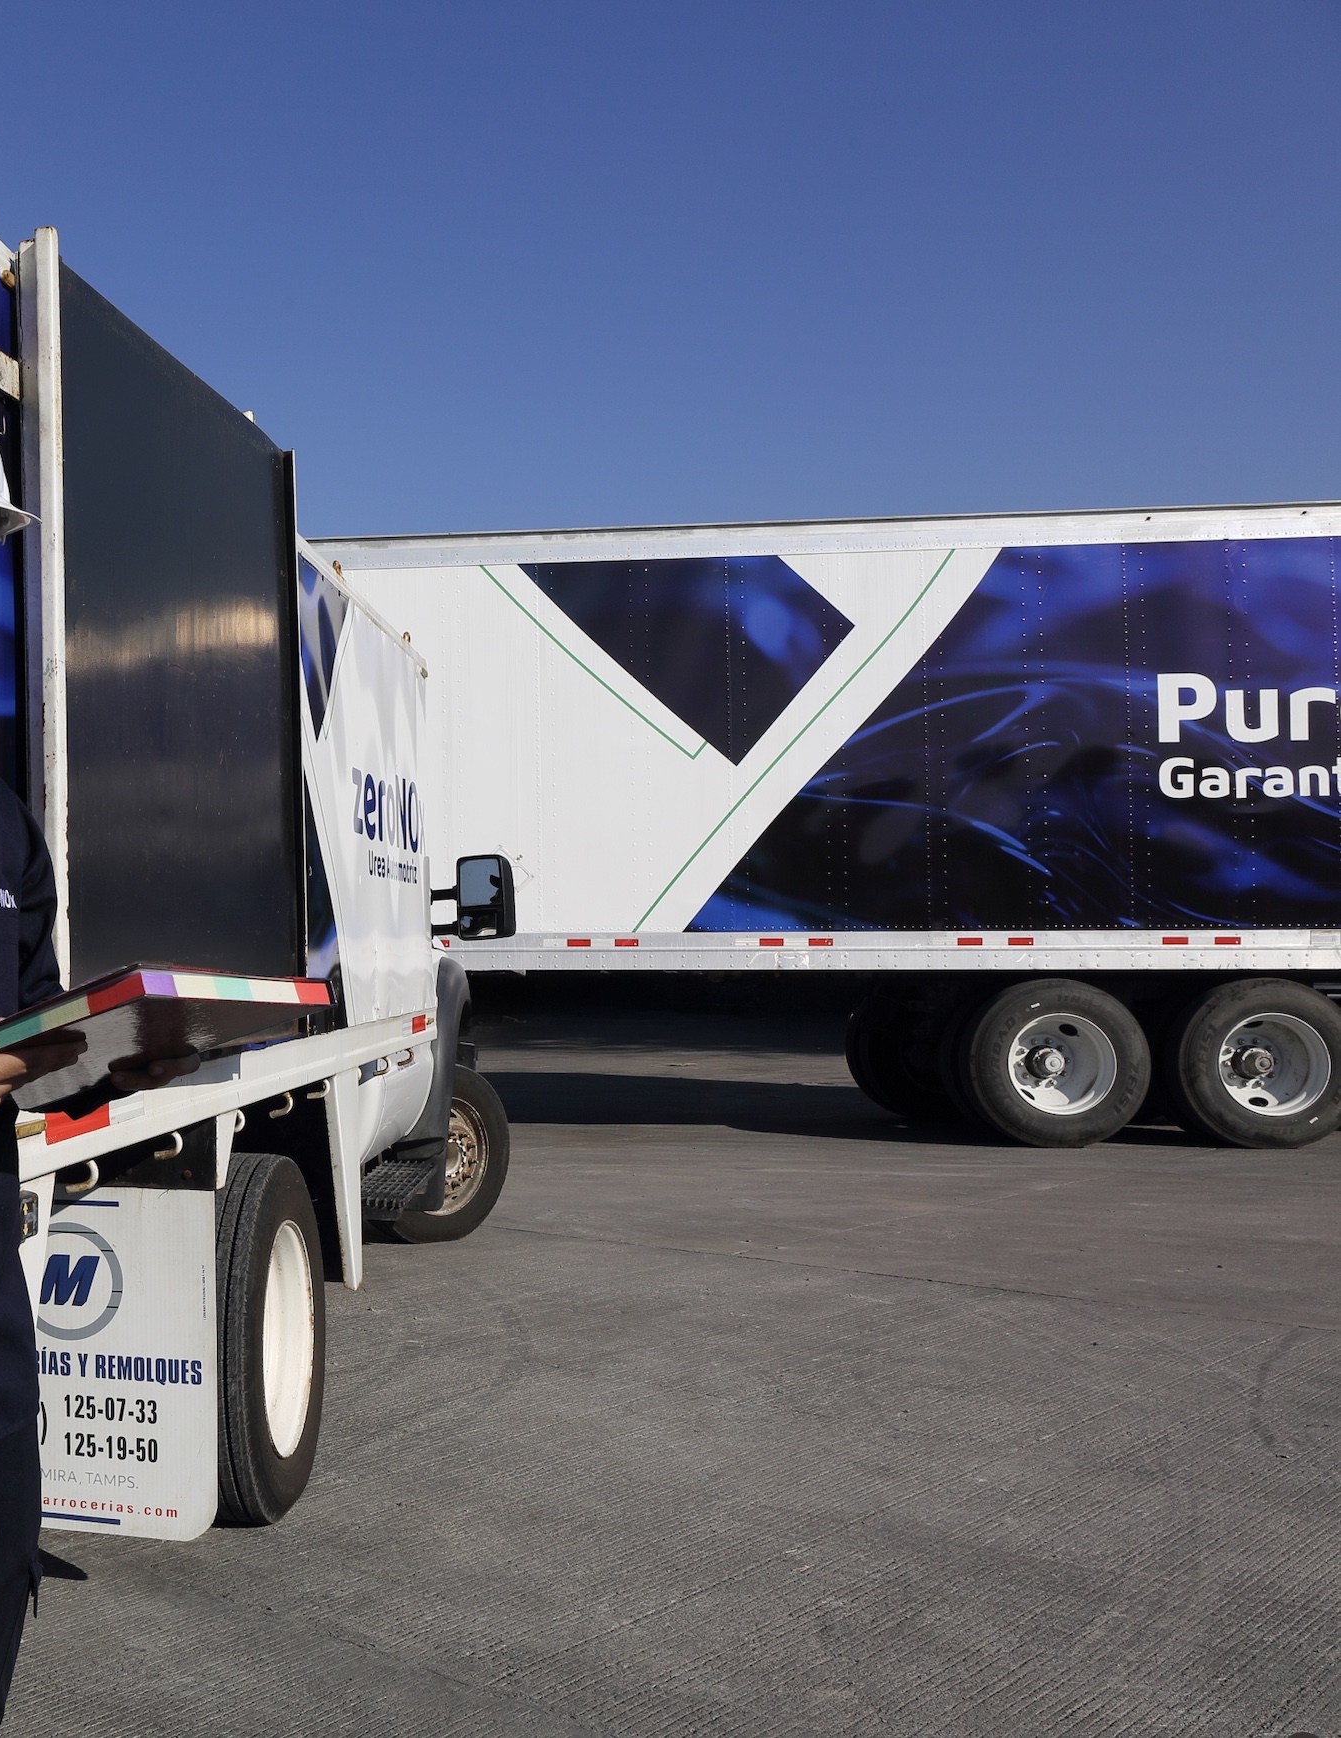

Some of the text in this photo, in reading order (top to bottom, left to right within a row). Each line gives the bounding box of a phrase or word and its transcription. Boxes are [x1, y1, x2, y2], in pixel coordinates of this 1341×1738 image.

[352, 767, 425, 855] zeroNOx
[368, 850, 386, 878] Urea
[77, 1353, 89, 1378] Y
[95, 1354, 202, 1386] REMOLQUES
[64, 1394, 158, 1424] 125-07-33
[64, 1432, 158, 1463] 125-19-50
[85, 1472, 139, 1489] TAMPS.
[43, 1496, 178, 1518] arrocerias.com
